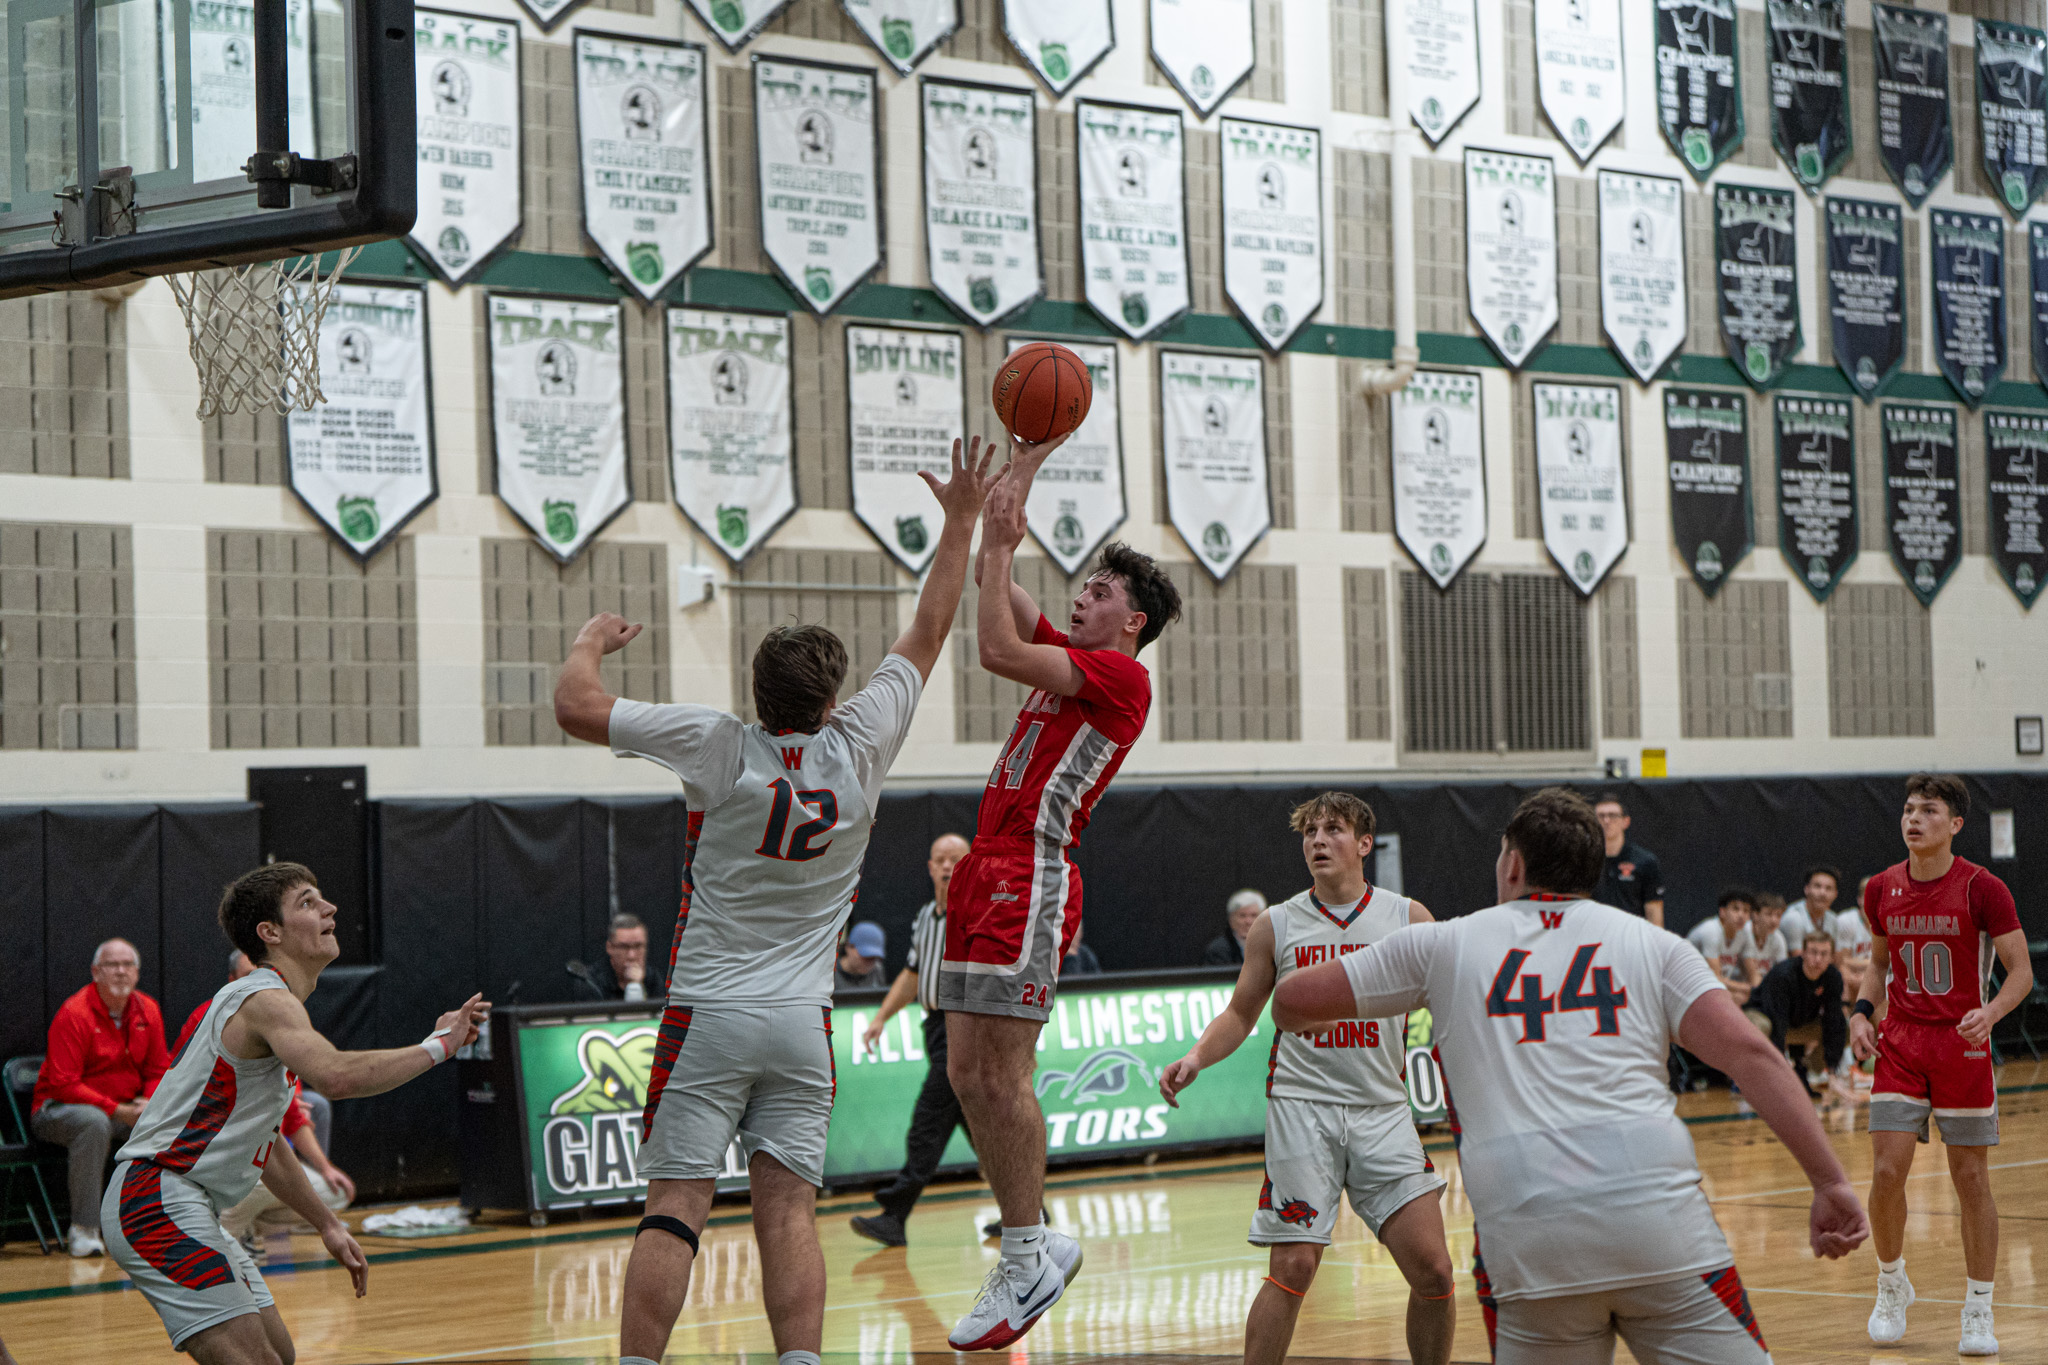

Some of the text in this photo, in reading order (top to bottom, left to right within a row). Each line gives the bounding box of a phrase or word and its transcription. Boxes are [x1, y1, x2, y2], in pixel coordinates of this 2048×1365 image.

[584, 54, 698, 100] TRACK
[762, 81, 871, 123] TRACK
[1229, 137, 1313, 169] TRACK
[1473, 166, 1548, 196] TRACK
[931, 208, 1028, 231] BLAKE EATON
[1087, 224, 1176, 247] BLAKE EATON
[495, 314, 617, 355] TRACK
[674, 326, 786, 365] TRACK
[856, 343, 956, 381] BOWLING
[781, 747, 804, 770] W
[755, 777, 838, 862] 12
[1540, 910, 1563, 930] W
[1886, 915, 1961, 936] SALAMANCA
[1899, 941, 1954, 996] 10
[1021, 982, 1048, 1008] 24
[1486, 942, 1627, 1045] 44
[1046, 1103, 1169, 1149] TORS
